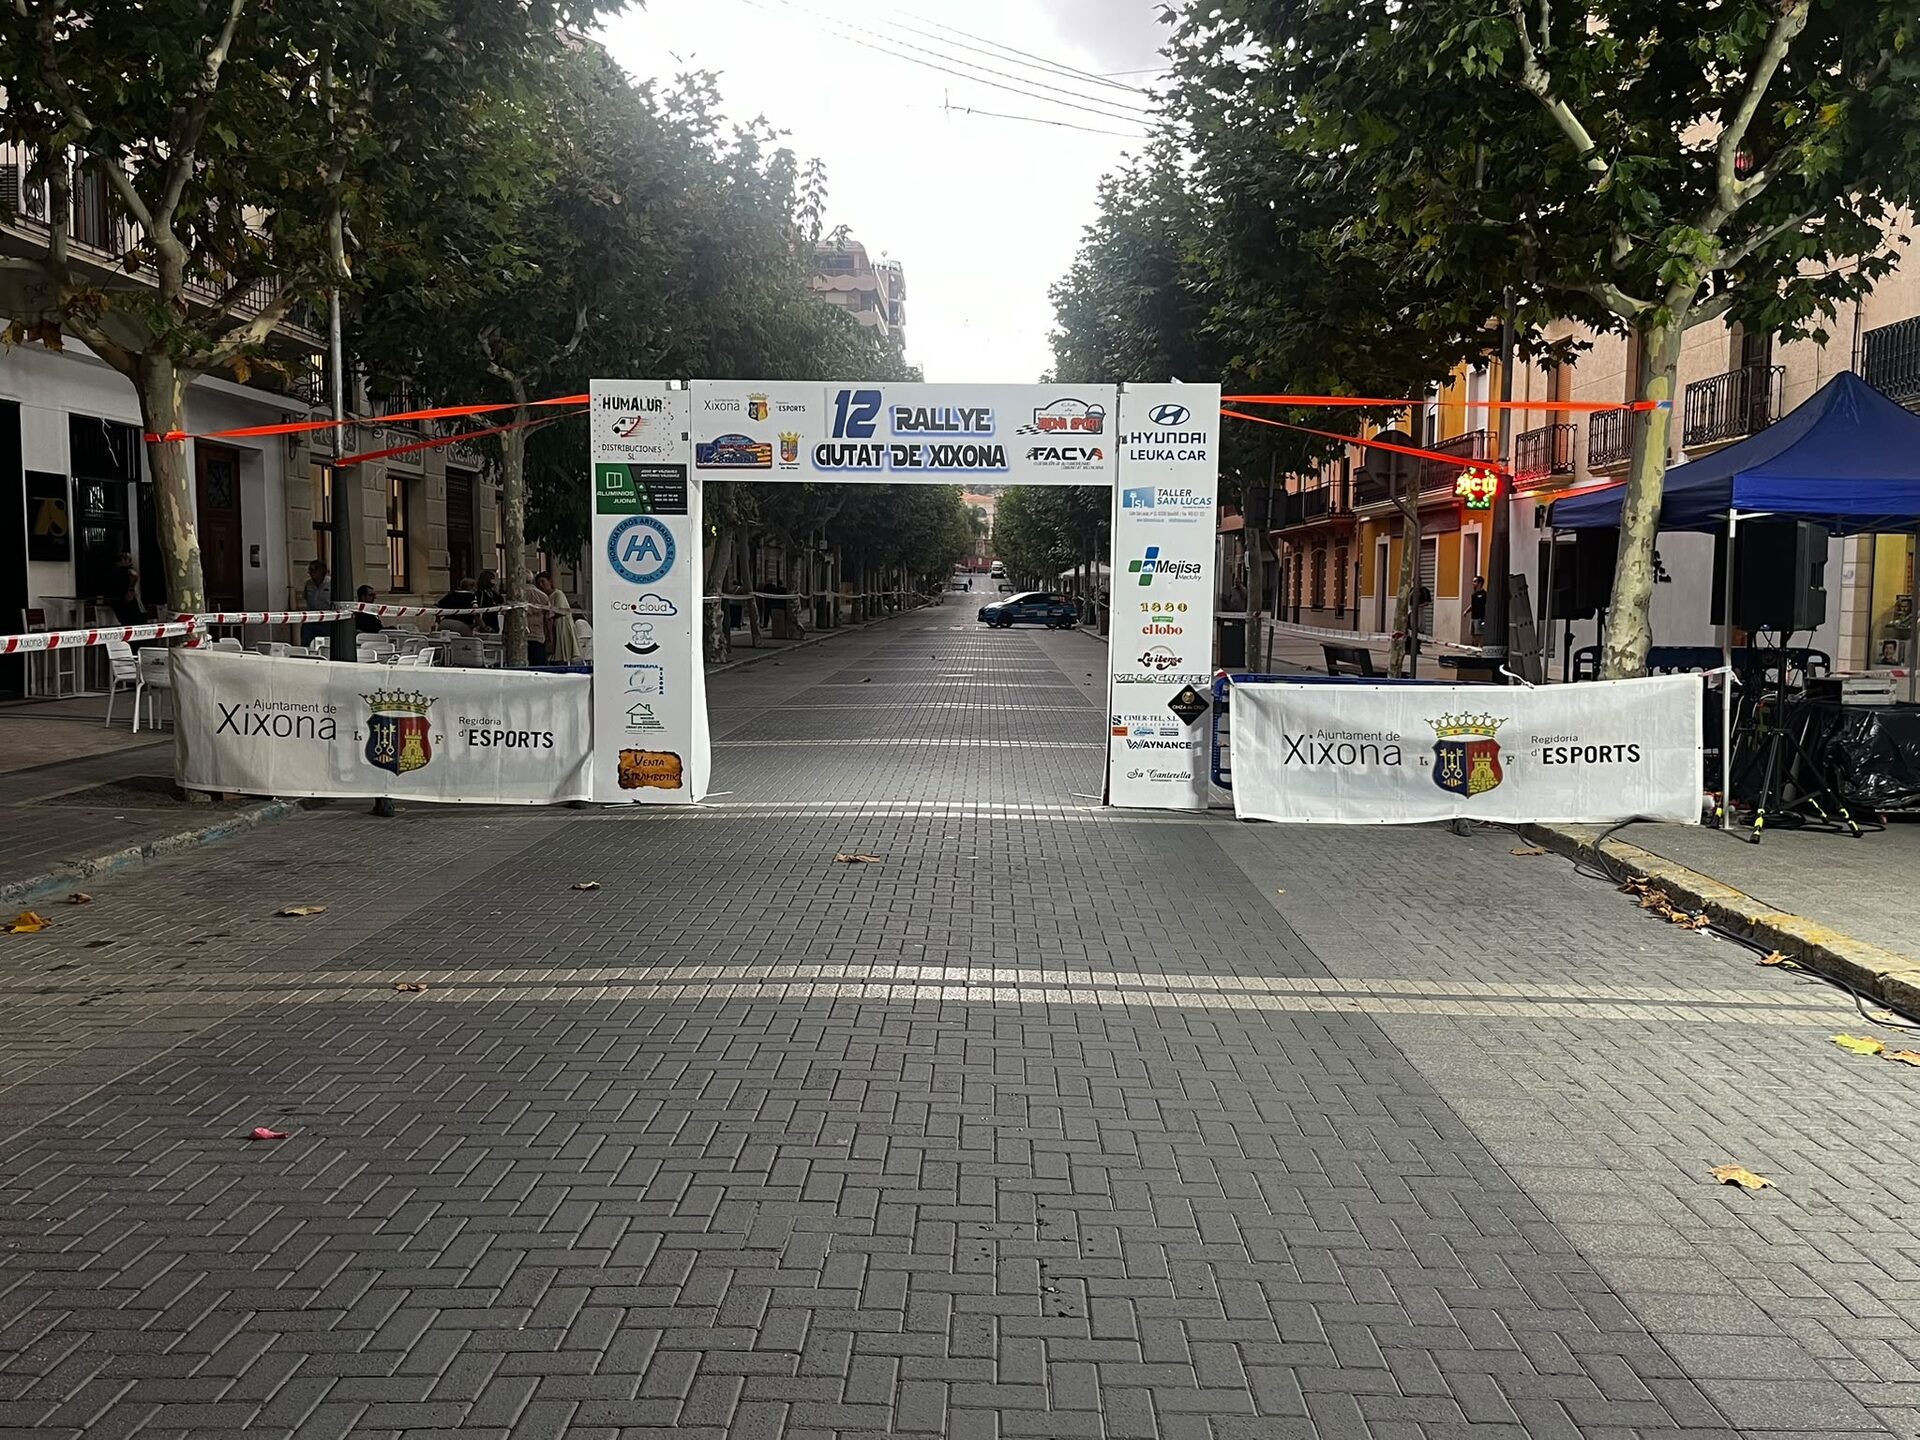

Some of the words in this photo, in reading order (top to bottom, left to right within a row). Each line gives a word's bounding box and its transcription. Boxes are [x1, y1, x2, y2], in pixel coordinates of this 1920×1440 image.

[602, 396, 663, 412] HUMALUR
[704, 400, 740, 411] Xixona
[832, 389, 882, 438] 12
[895, 407, 992, 431] RALLYE
[1131, 432, 1206, 444] HYUNDAI
[601, 443, 662, 453] DISTRIBUCIONES
[815, 443, 884, 466] CIUTAT
[892, 444, 922, 466] DE
[928, 444, 1006, 467] XIXONA
[1130, 449, 1175, 460] LEUKA
[1177, 449, 1206, 460] CAR
[1158, 489, 1192, 497] TALLER
[1157, 497, 1178, 505] SAN
[1180, 497, 1212, 505] LUCAS
[1155, 560, 1201, 579] Mejisa
[610, 601, 631, 611] iCar
[639, 602, 667, 612] cloud
[1142, 624, 1153, 634] el
[1155, 624, 1182, 634] lobo
[253, 699, 319, 713] Ajuntament
[322, 704, 337, 714] de
[216, 703, 337, 740] Xixona
[458, 717, 502, 726] Regidoria
[435, 735, 444, 745] F
[458, 729, 554, 748] d'ESPORTS
[1317, 730, 1382, 741] Ajuntament
[1386, 731, 1400, 742] de
[1531, 734, 1579, 744] Regidoria
[1126, 739, 1192, 750] WAYNANCE
[1283, 734, 1402, 766] Xixona
[634, 754, 664, 766] VENTA
[1531, 744, 1641, 765] d'ESPORTS
[1505, 756, 1514, 765] F
[1127, 768, 1144, 779] Sa
